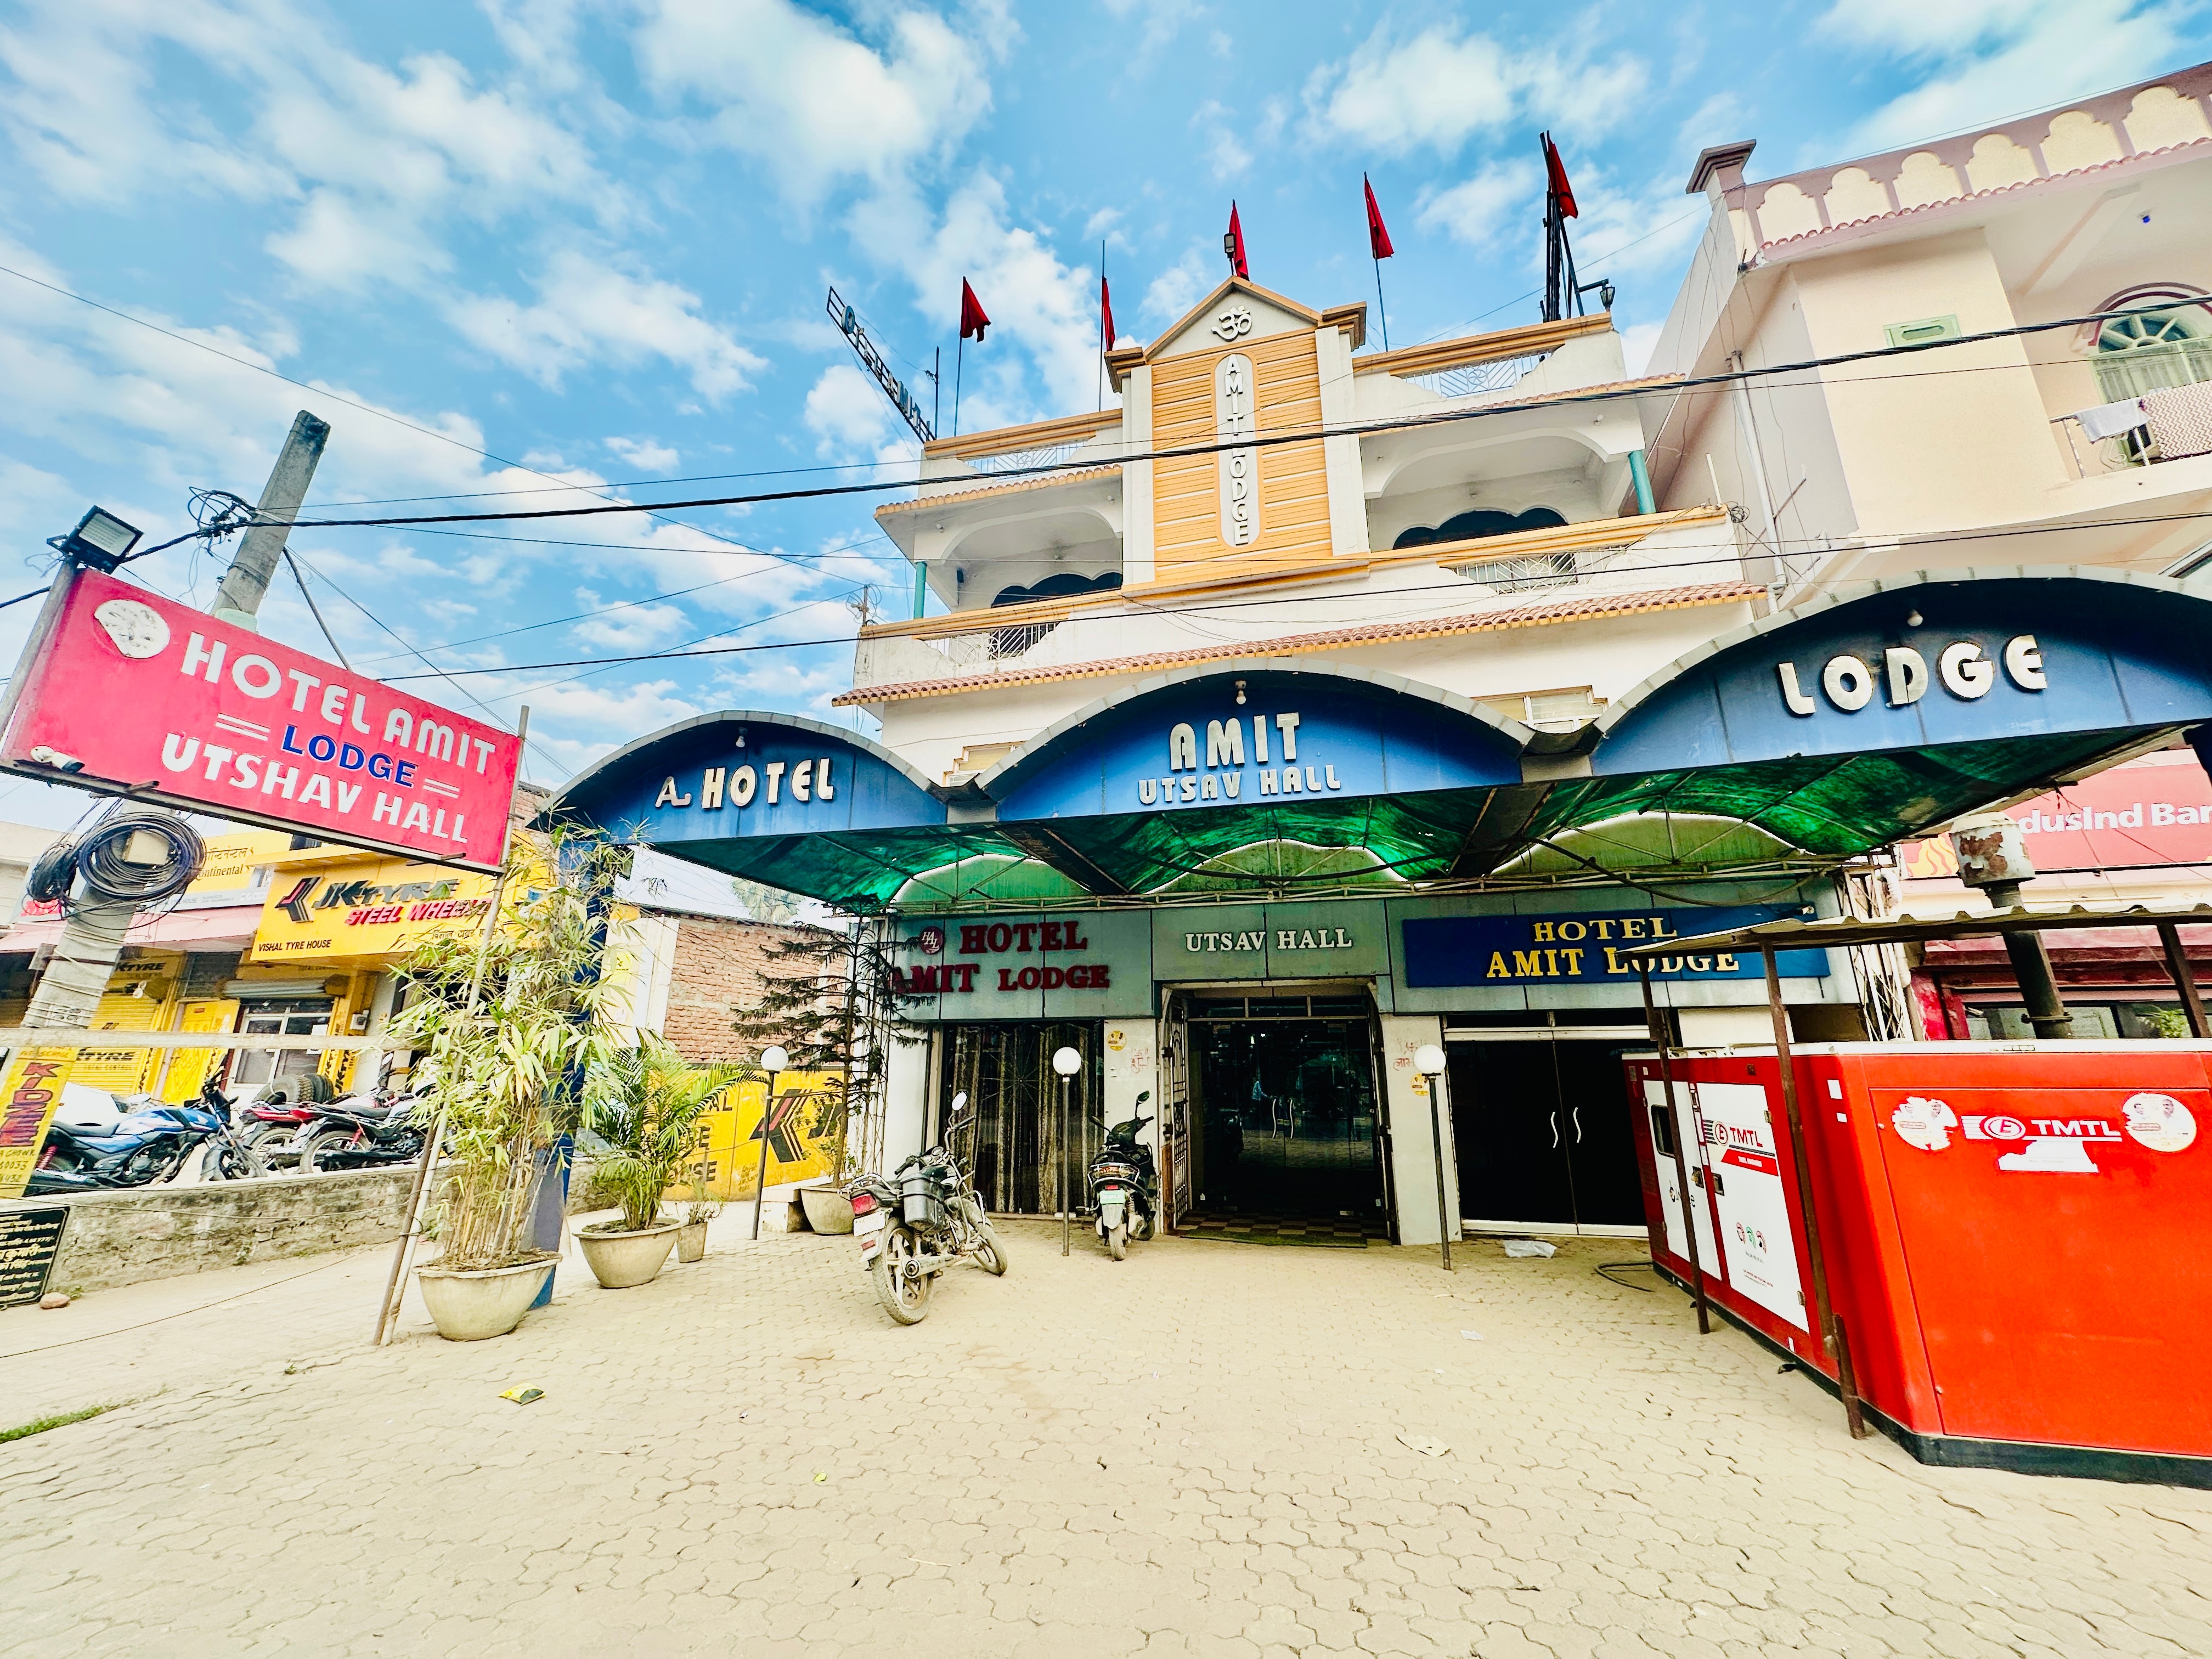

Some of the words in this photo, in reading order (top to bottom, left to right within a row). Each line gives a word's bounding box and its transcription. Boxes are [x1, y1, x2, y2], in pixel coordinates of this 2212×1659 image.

[1224, 353, 1244, 435] AMIT
[1776, 634, 2048, 716] LODGE
[180, 631, 371, 735] HOTEL
[383, 708, 496, 775] AMIT
[281, 724, 419, 788] LODGE
[1170, 712, 1300, 771] AMIT
[161, 732, 363, 816] UTSHAV
[371, 791, 468, 844] HALL
[701, 758, 834, 809] HOTEL
[1138, 771, 1242, 805] UTSAV
[1259, 764, 1341, 795] HALL
[2017, 802, 2143, 834] dusInd
[345, 905, 402, 926] STEEL
[1533, 917, 1677, 942] HOTEL
[258, 943, 283, 952] VISHAL
[286, 941, 304, 950] TYRE
[306, 939, 332, 949] HOUSE
[959, 920, 1087, 953] HOTEL
[1185, 931, 1266, 952] UTSAV
[1277, 928, 1353, 950] HALL
[887, 963, 980, 994] AMIT
[997, 964, 1110, 991] LODGE
[1486, 948, 1584, 978] AMIT
[1729, 1126, 1763, 1148] TMTL
[2030, 1119, 2121, 1136] TMTL
